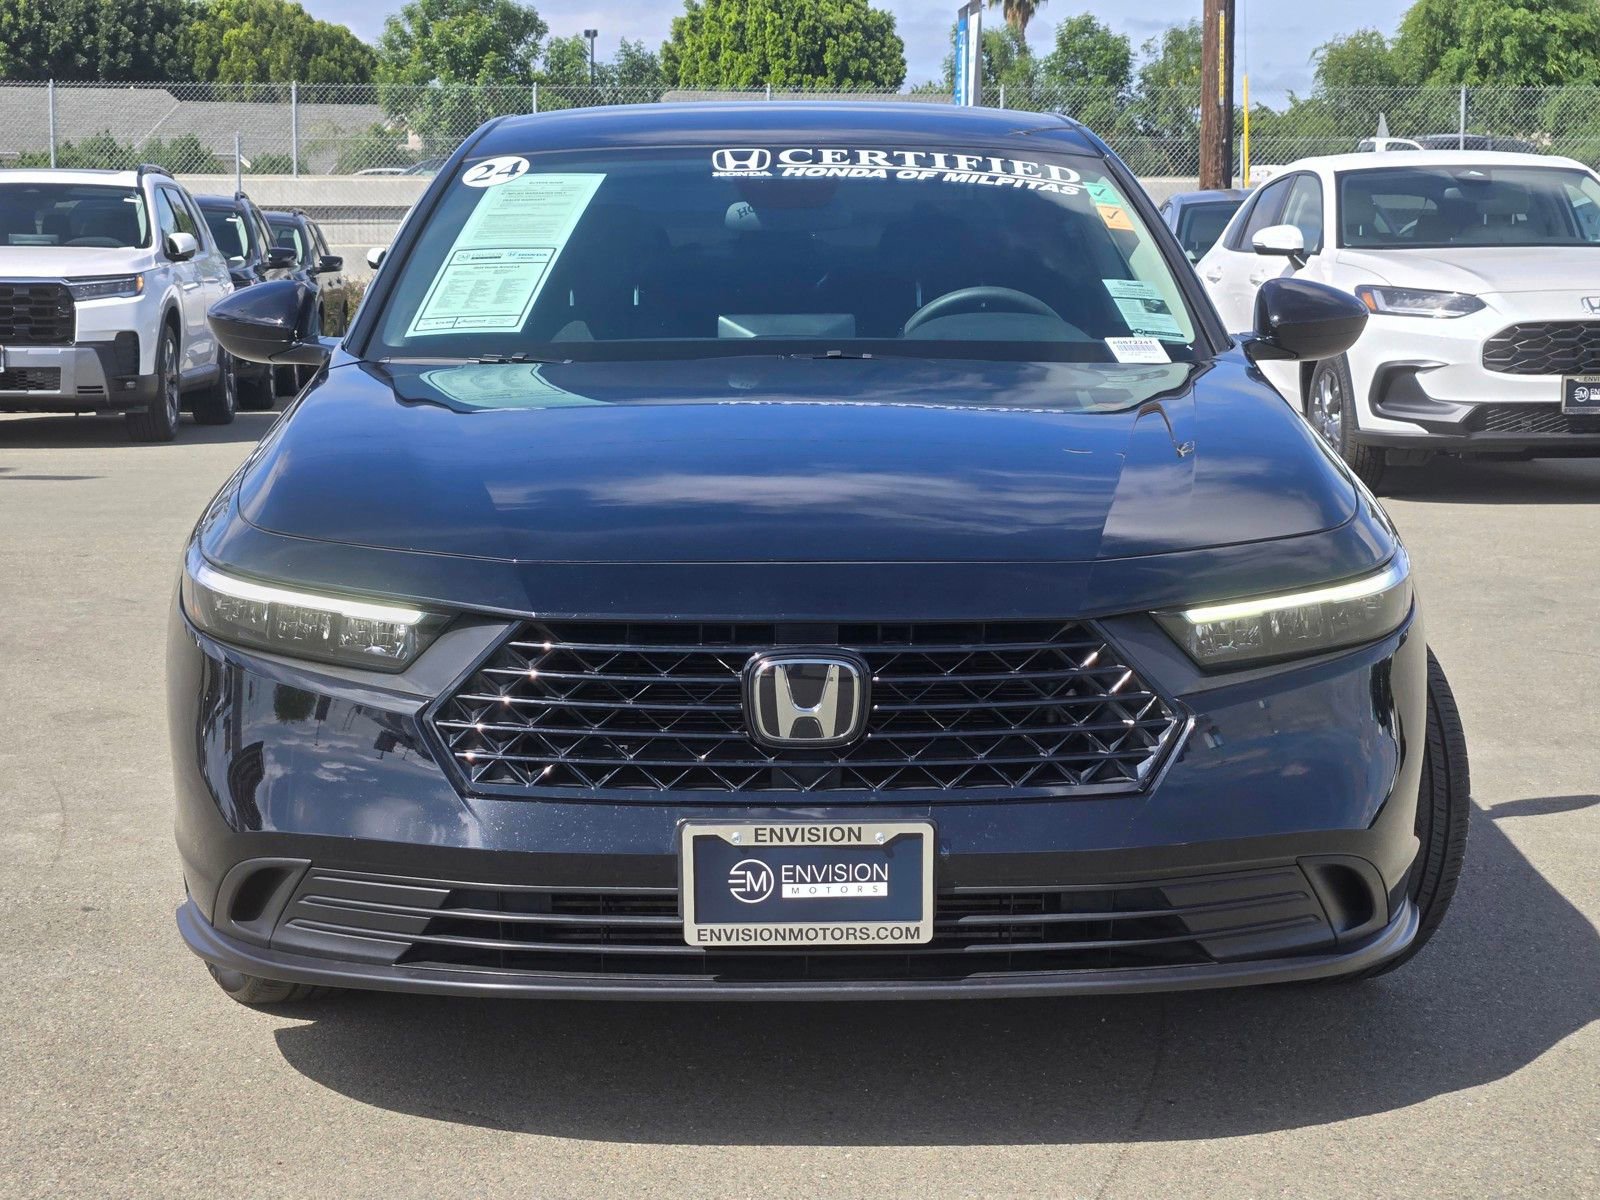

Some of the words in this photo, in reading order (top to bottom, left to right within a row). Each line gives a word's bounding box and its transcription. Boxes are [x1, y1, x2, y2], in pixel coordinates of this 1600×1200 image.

[468, 160, 523, 182] 24
[778, 149, 1081, 183] CERTIFIED
[782, 168, 888, 178] HONDA
[896, 170, 939, 180] OF
[943, 173, 1080, 196] MILPITAS
[754, 827, 862, 843] ENVISION
[781, 863, 889, 882] ENVISION
[791, 886, 879, 895] MOTORS
[697, 926, 921, 942] ENVISIONMOTORS.COM
